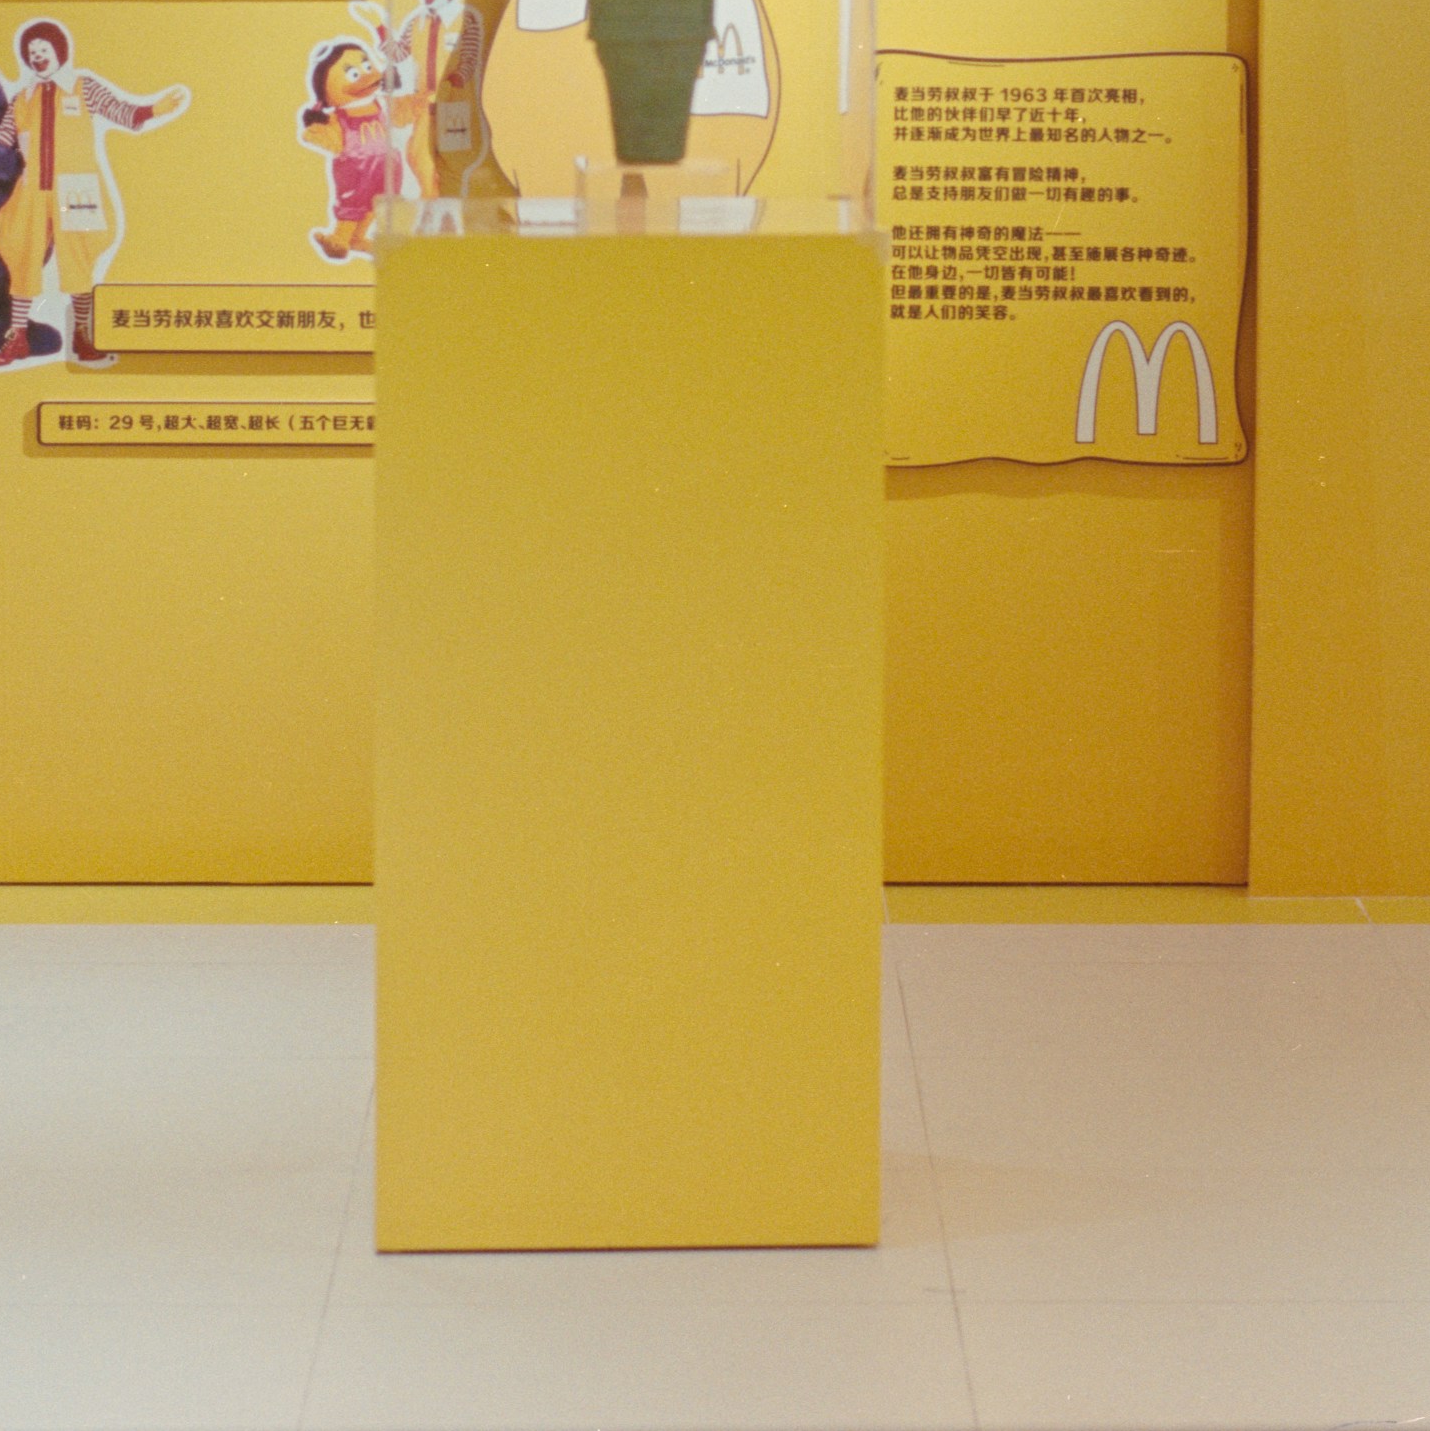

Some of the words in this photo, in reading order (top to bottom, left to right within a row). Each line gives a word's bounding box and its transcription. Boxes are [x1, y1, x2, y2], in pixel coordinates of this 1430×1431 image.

[1001, 87, 1048, 103] 1963
[893, 126, 1172, 144] 并逐渐成为世界上最知名的人物之一。
[892, 165, 1087, 184] 麦当劳叔叔富有冒险精神，
[892, 186, 1139, 203] 总是支持朋友们做一切有趣的事。
[891, 245, 1197, 263] 可以让物品凭空出现，甚至施展各种奇迹。
[891, 265, 1076, 282] 在他身边，一切皆有可能！
[890, 284, 1196, 303] 但最重要的是，麦当劳叔叔最喜欢看到的，
[889, 304, 1017, 321] 就是人们的笑容。
